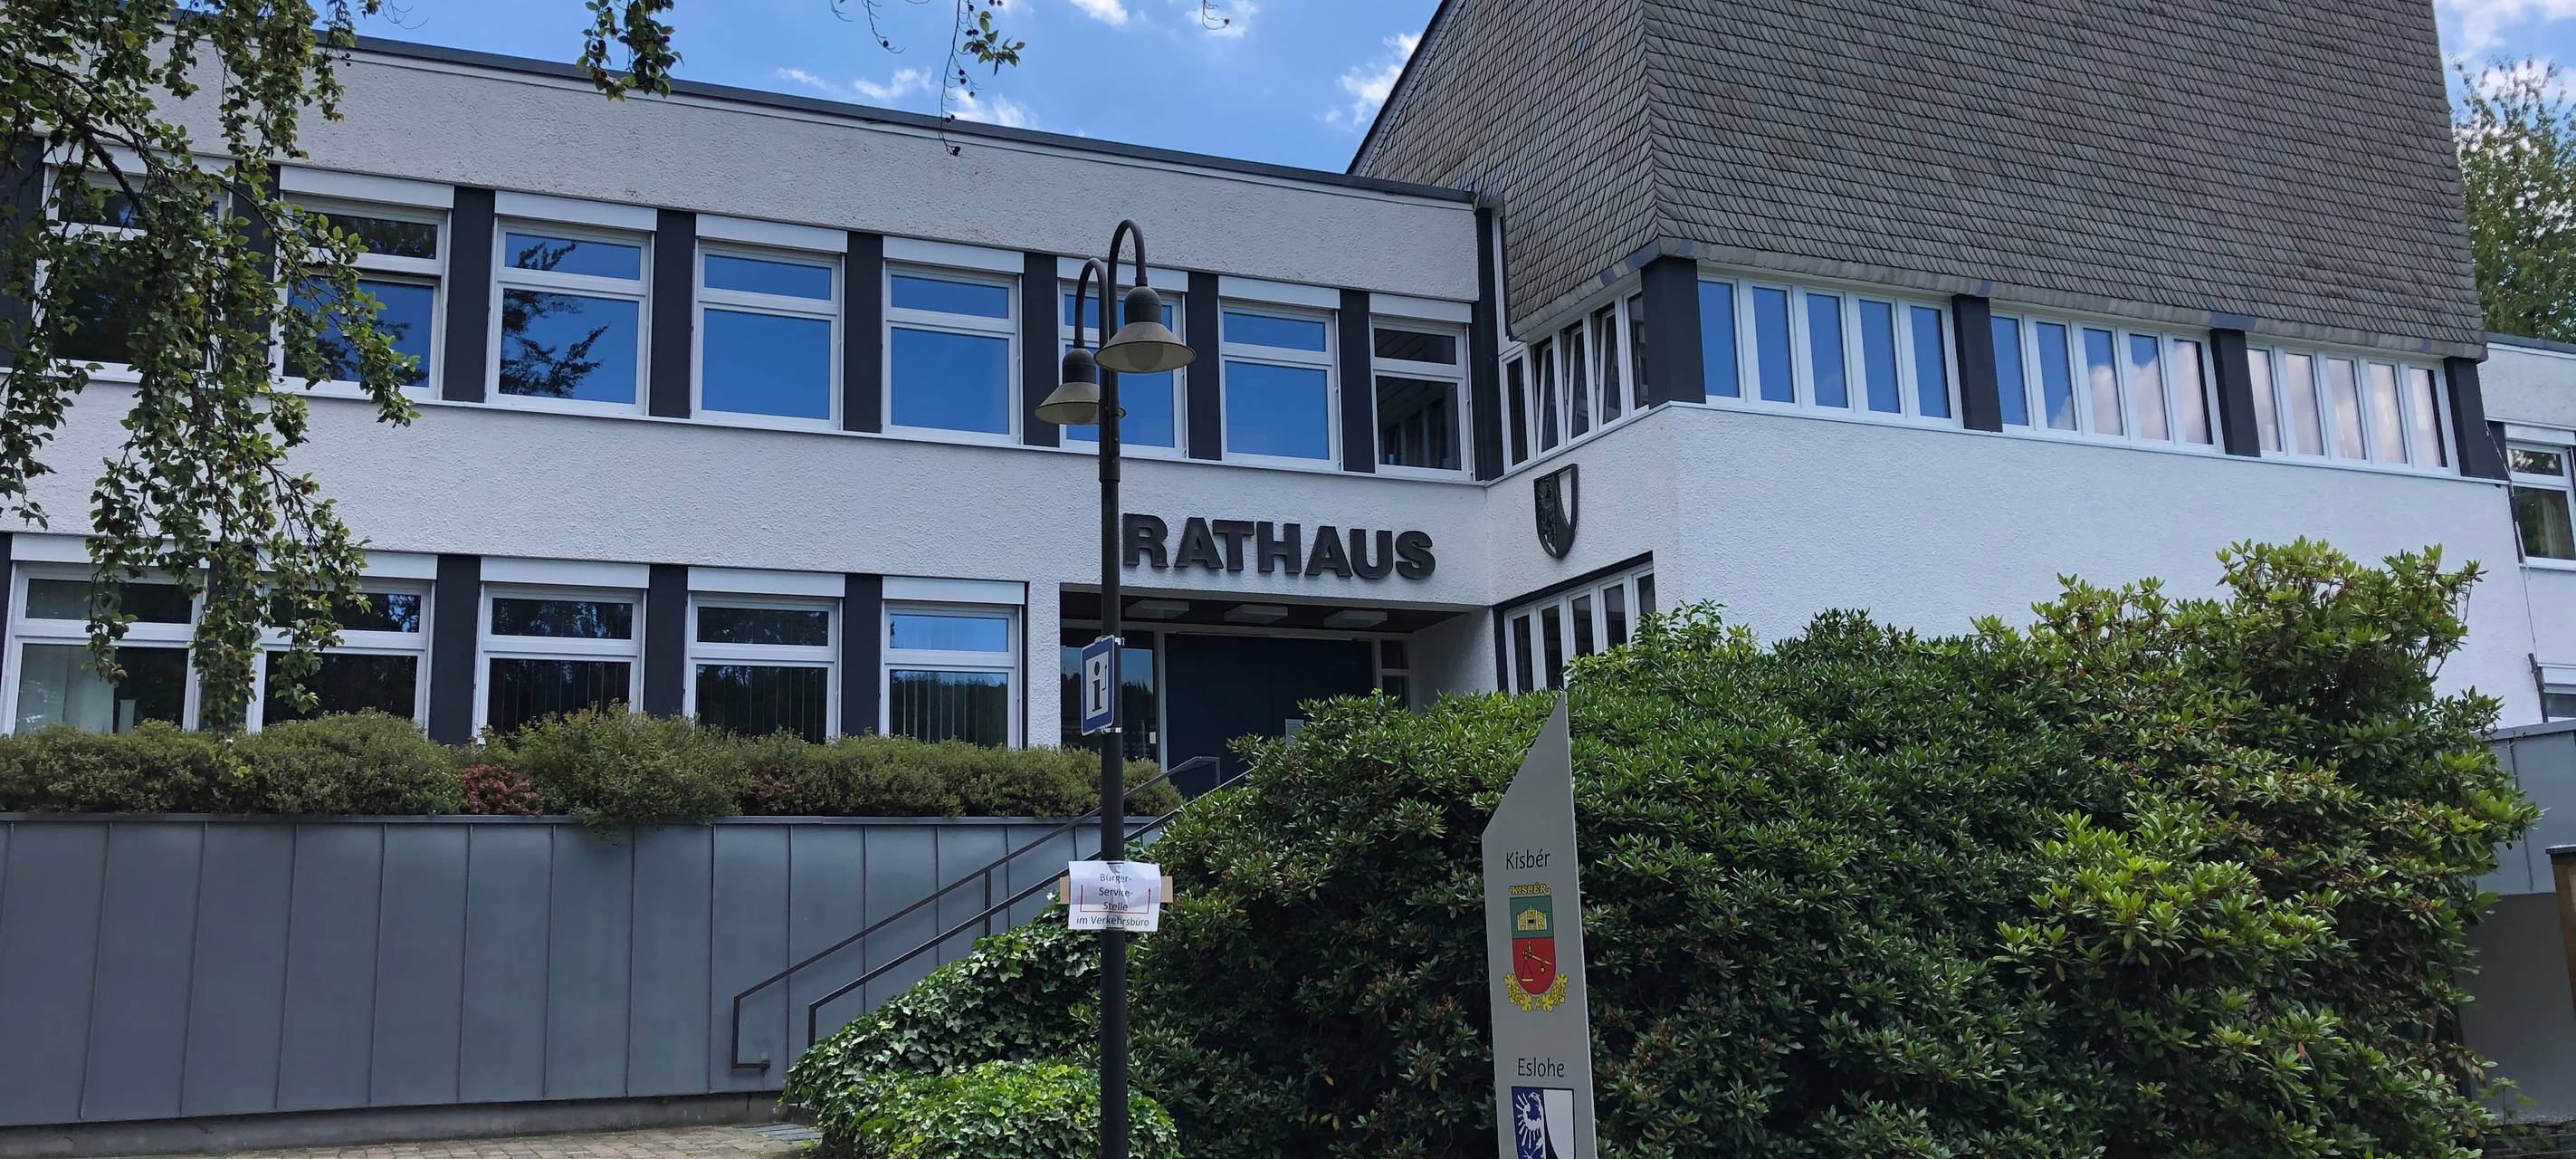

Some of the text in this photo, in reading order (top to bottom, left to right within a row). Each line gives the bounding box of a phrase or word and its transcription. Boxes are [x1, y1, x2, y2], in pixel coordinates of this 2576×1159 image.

[1122, 512, 1436, 580] RATHAUS
[1092, 661, 1102, 712] i
[1505, 848, 1550, 870] Kisbér
[1099, 886, 1133, 897] Service-
[1103, 901, 1129, 912] Stelle
[1076, 915, 1150, 926] im Verkehrsbüro
[1517, 1057, 1565, 1078] Eslohe
